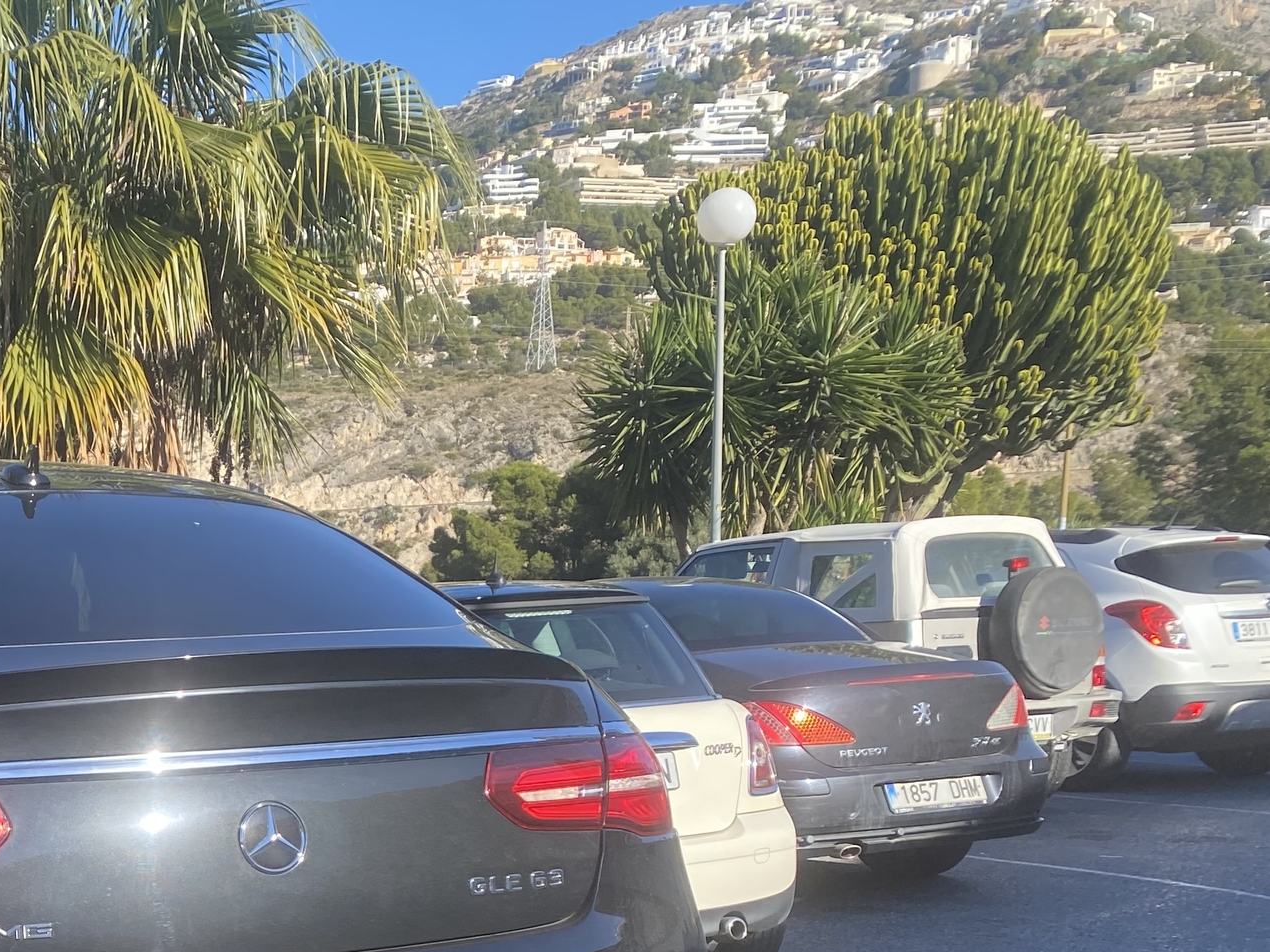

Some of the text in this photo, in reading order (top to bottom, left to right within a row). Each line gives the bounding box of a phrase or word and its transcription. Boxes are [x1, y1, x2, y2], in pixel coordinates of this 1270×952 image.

[1240, 622, 1269, 637] 3811
[704, 742, 733, 757] COOPER
[839, 746, 889, 758] PEUGEOT
[900, 777, 981, 804] 1857 DHM
[469, 868, 564, 896] GLE 63
